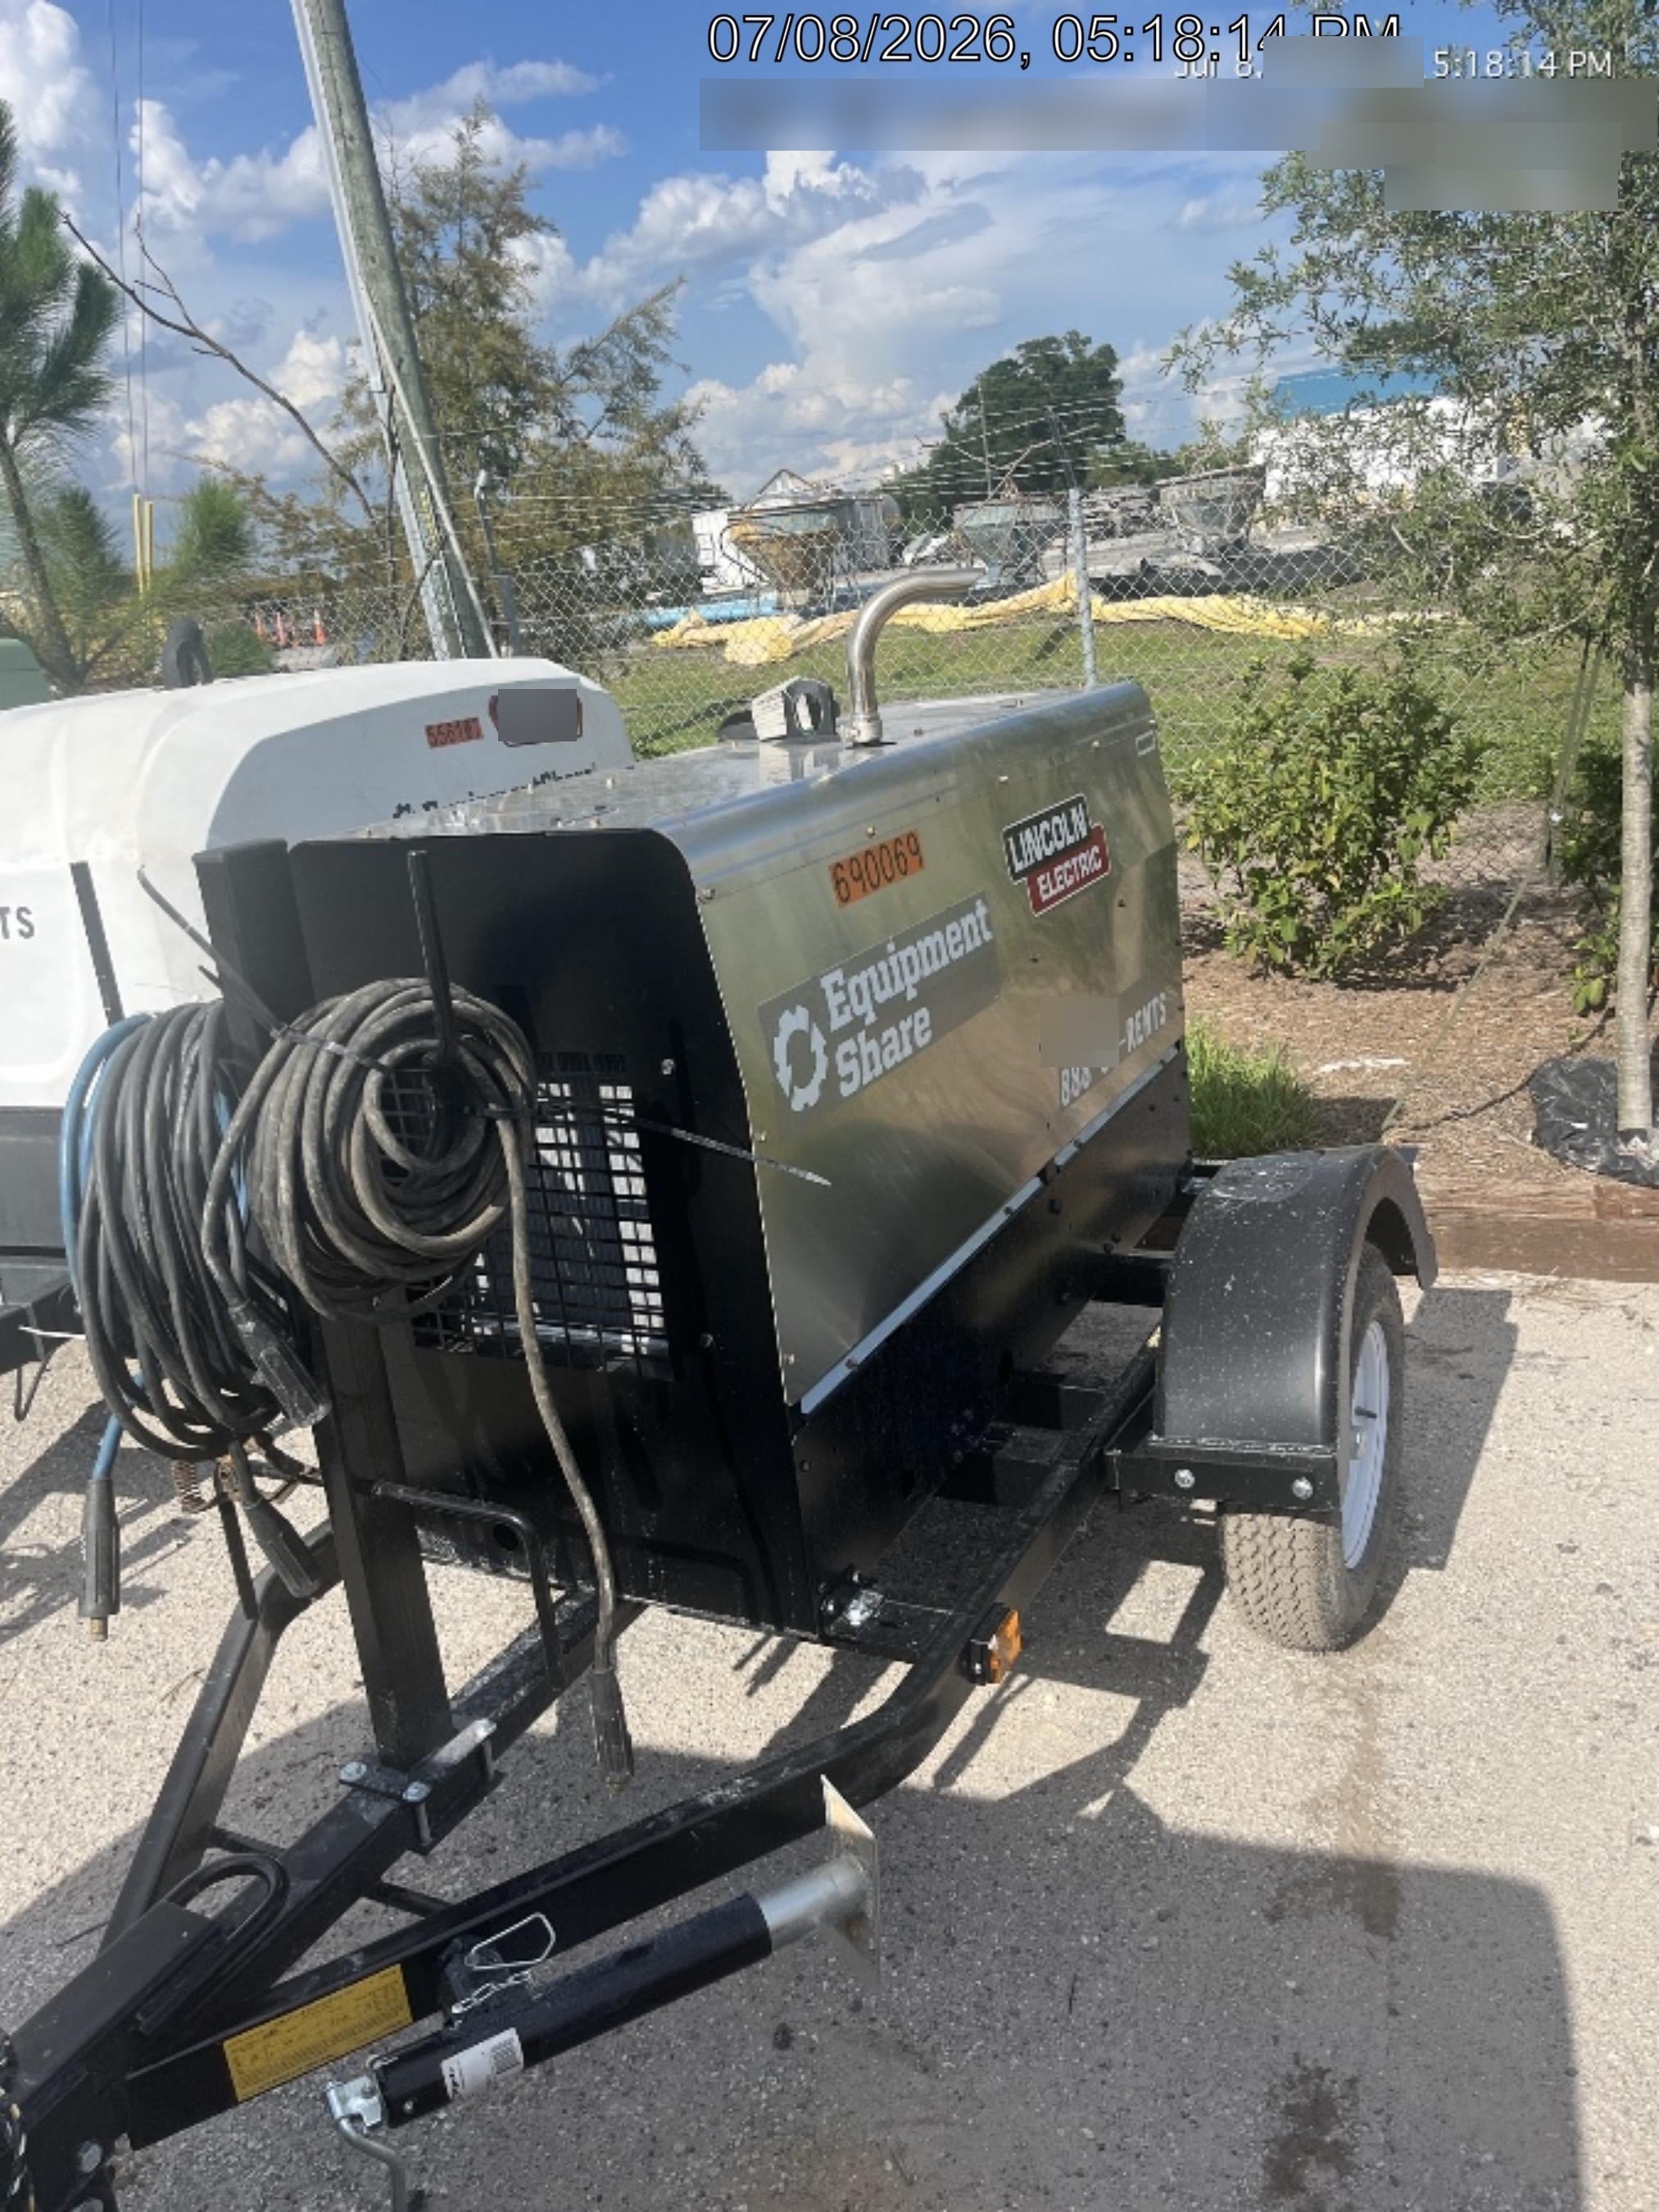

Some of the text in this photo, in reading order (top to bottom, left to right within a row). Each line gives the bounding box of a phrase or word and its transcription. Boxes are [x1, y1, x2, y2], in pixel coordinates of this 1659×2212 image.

[833, 832, 923, 903] 690069
[1008, 803, 1087, 873] LINCOLN
[1036, 845, 1102, 903] ELECTRIC
[820, 899, 993, 1032] Equipment
[835, 1006, 931, 1098] Share
